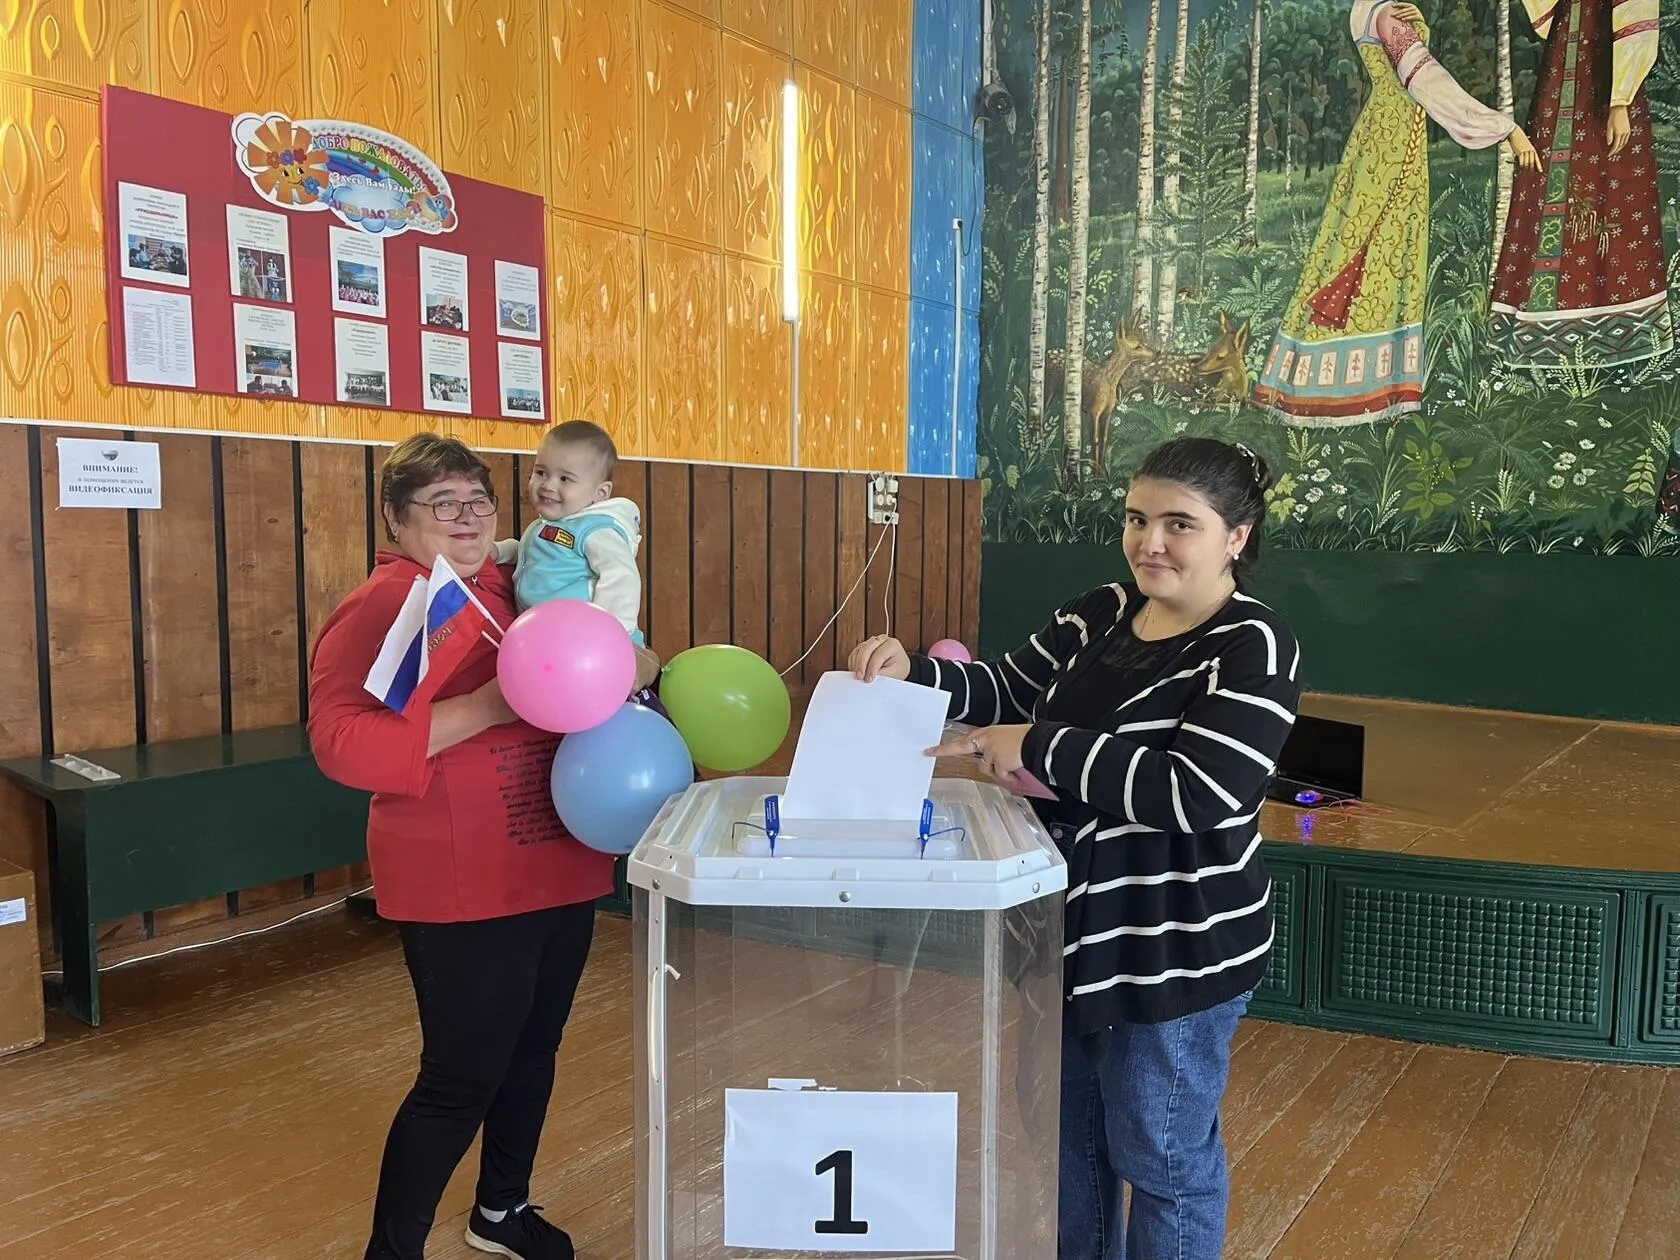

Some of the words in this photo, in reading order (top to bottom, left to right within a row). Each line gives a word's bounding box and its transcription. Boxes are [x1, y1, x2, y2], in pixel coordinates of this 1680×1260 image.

[312, 136, 349, 150] ДОБРО
[82, 464, 138, 474] ВНИМАНИЕ!
[68, 485, 153, 495] ВИДЕОФИКСАЦИЯ
[814, 1149, 869, 1234] 1
